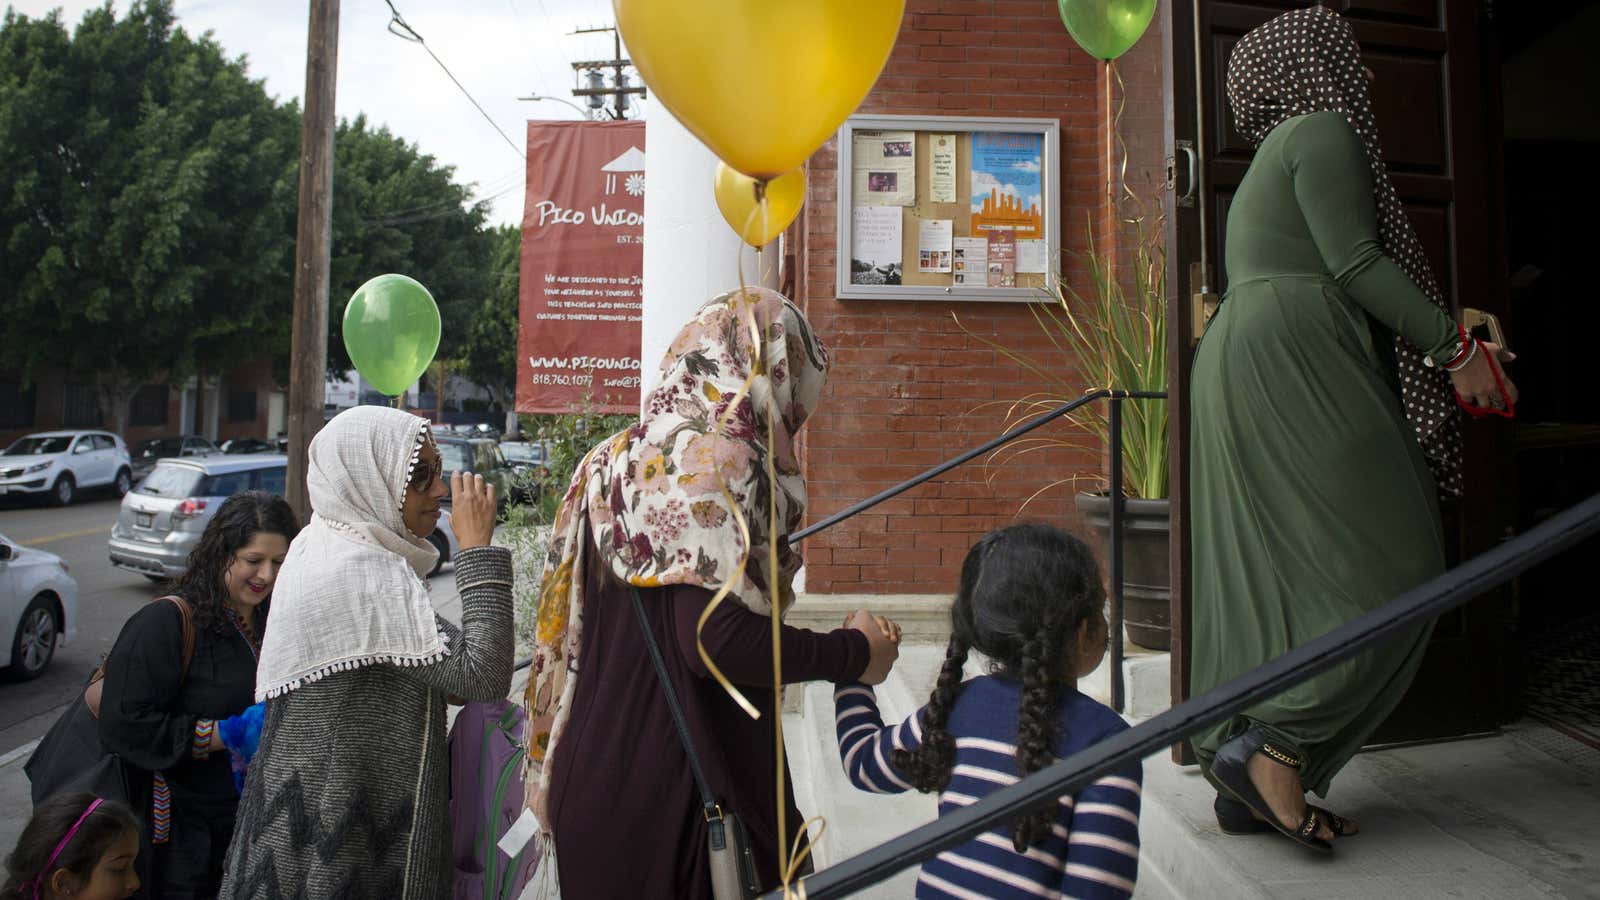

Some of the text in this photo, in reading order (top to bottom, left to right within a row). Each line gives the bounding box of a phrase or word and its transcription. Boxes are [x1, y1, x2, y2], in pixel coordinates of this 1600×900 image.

[536, 201, 585, 226] PICO
[616, 235, 634, 244] EST.
[557, 275, 570, 283] ARE
[571, 276, 608, 284] DEDICATED
[618, 277, 630, 285] THE
[543, 288, 560, 297] YOUR
[564, 301, 596, 309] TEACHING
[529, 356, 641, 370] WWW.PICOUNIO
